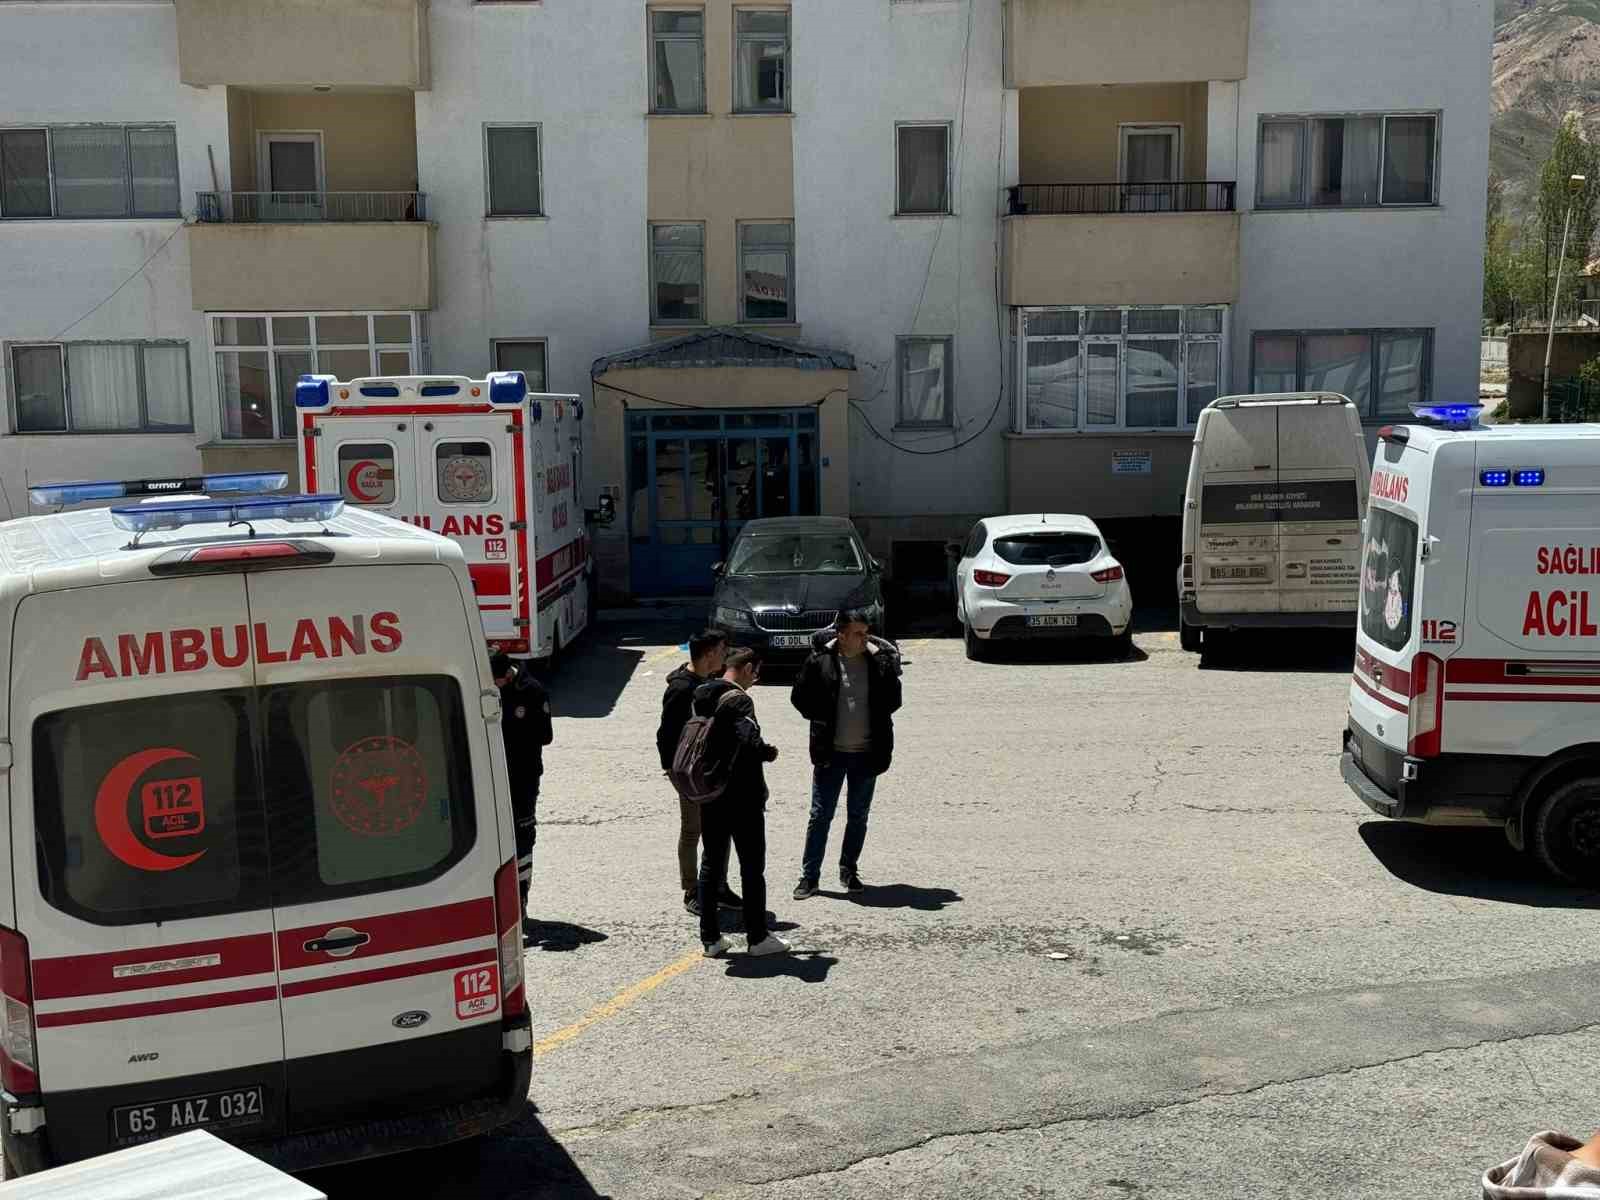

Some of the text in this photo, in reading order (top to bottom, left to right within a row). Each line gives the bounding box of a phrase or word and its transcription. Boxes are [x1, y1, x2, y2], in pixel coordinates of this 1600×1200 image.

[488, 541, 504, 551] 112
[1536, 543, 1600, 574] SAĞLI
[1422, 619, 1457, 640] 112
[75, 611, 403, 681] AMBULANS
[152, 783, 192, 810] 112
[114, 954, 220, 978] TRANSIT
[462, 970, 492, 995] 112
[128, 1052, 160, 1064] AWD
[129, 1091, 260, 1133] 65 AAZ 032
